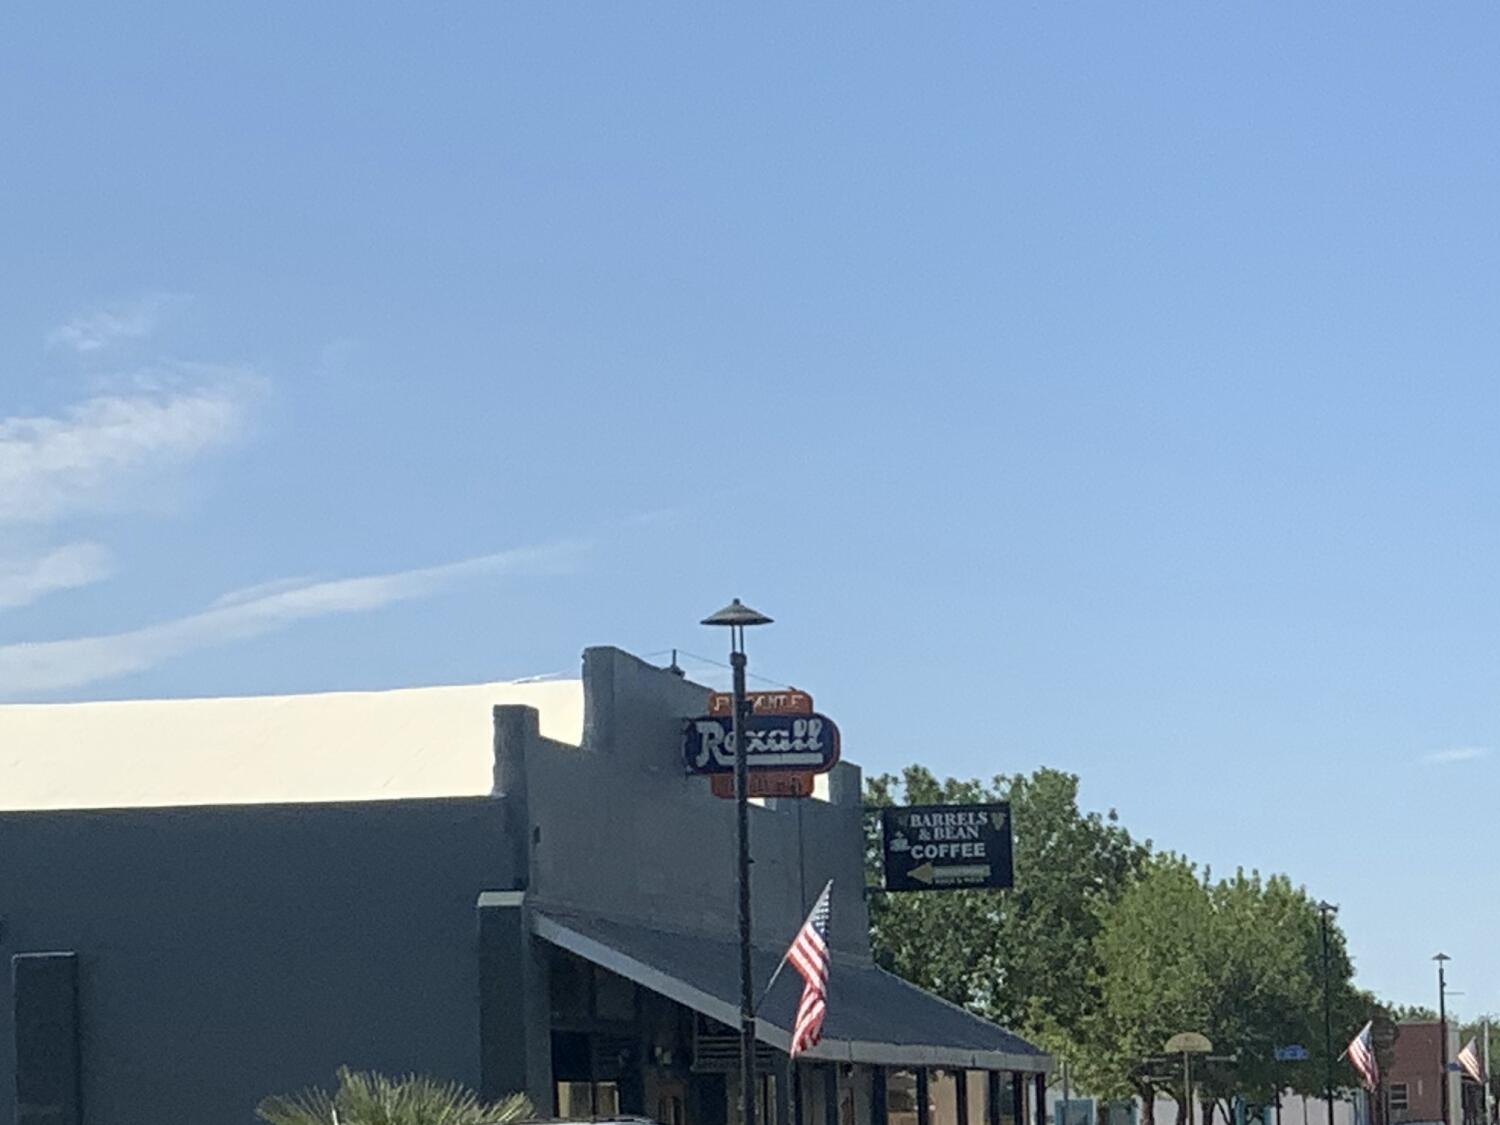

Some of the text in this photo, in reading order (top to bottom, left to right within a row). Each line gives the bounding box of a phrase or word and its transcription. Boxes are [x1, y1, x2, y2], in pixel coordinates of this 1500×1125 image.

[696, 718, 823, 767] Rexall
[910, 811, 988, 828] BARRELS
[918, 825, 980, 840] & BEAN
[911, 842, 986, 859] COFFEE
